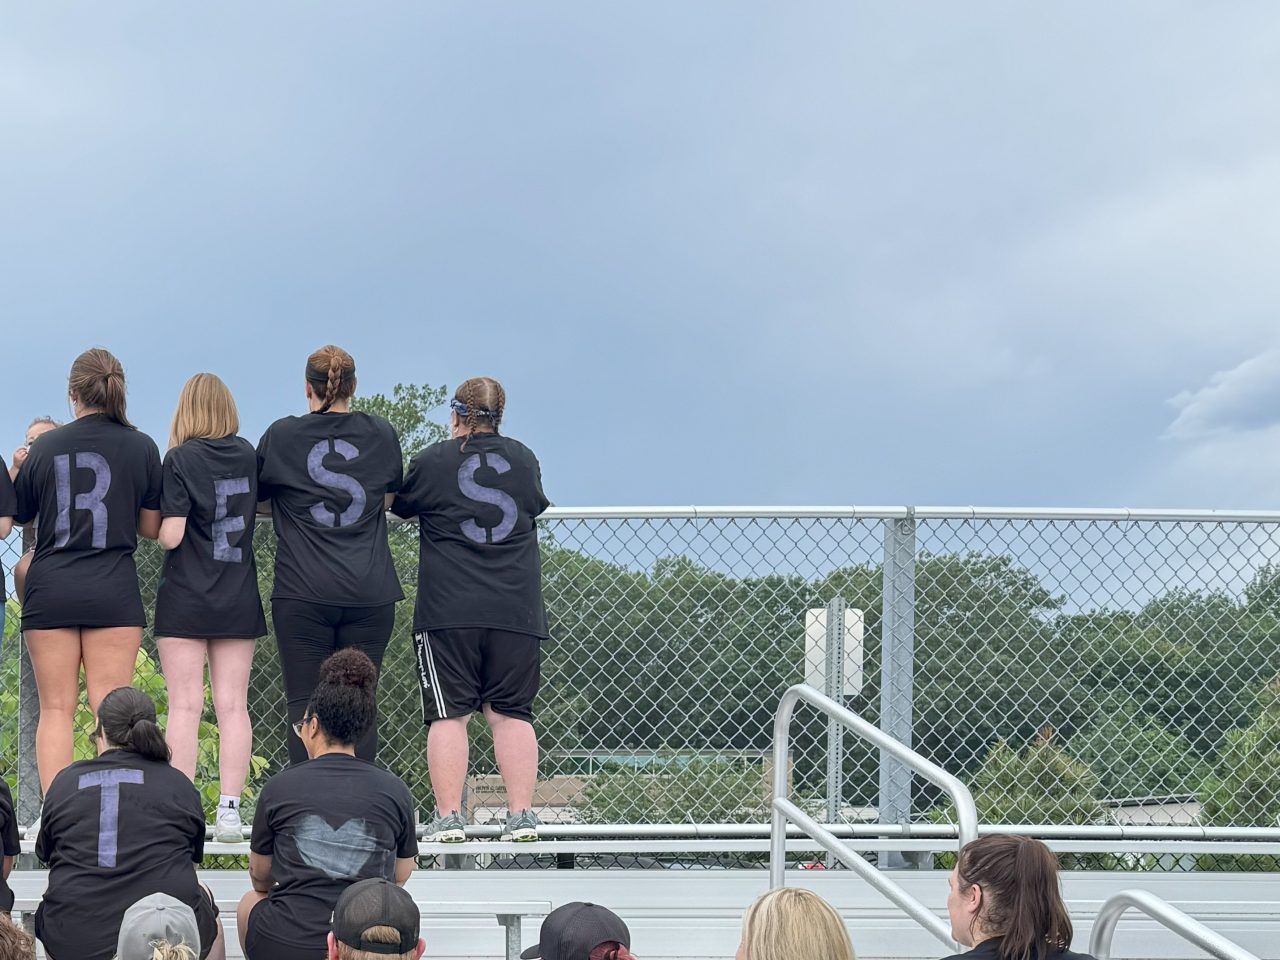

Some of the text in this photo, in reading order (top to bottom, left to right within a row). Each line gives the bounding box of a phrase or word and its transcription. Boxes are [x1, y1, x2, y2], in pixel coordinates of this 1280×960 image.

[54, 451, 112, 549] R
[212, 477, 250, 563] E
[306, 438, 367, 528] S
[457, 452, 519, 544] S
[78, 768, 145, 868] T
